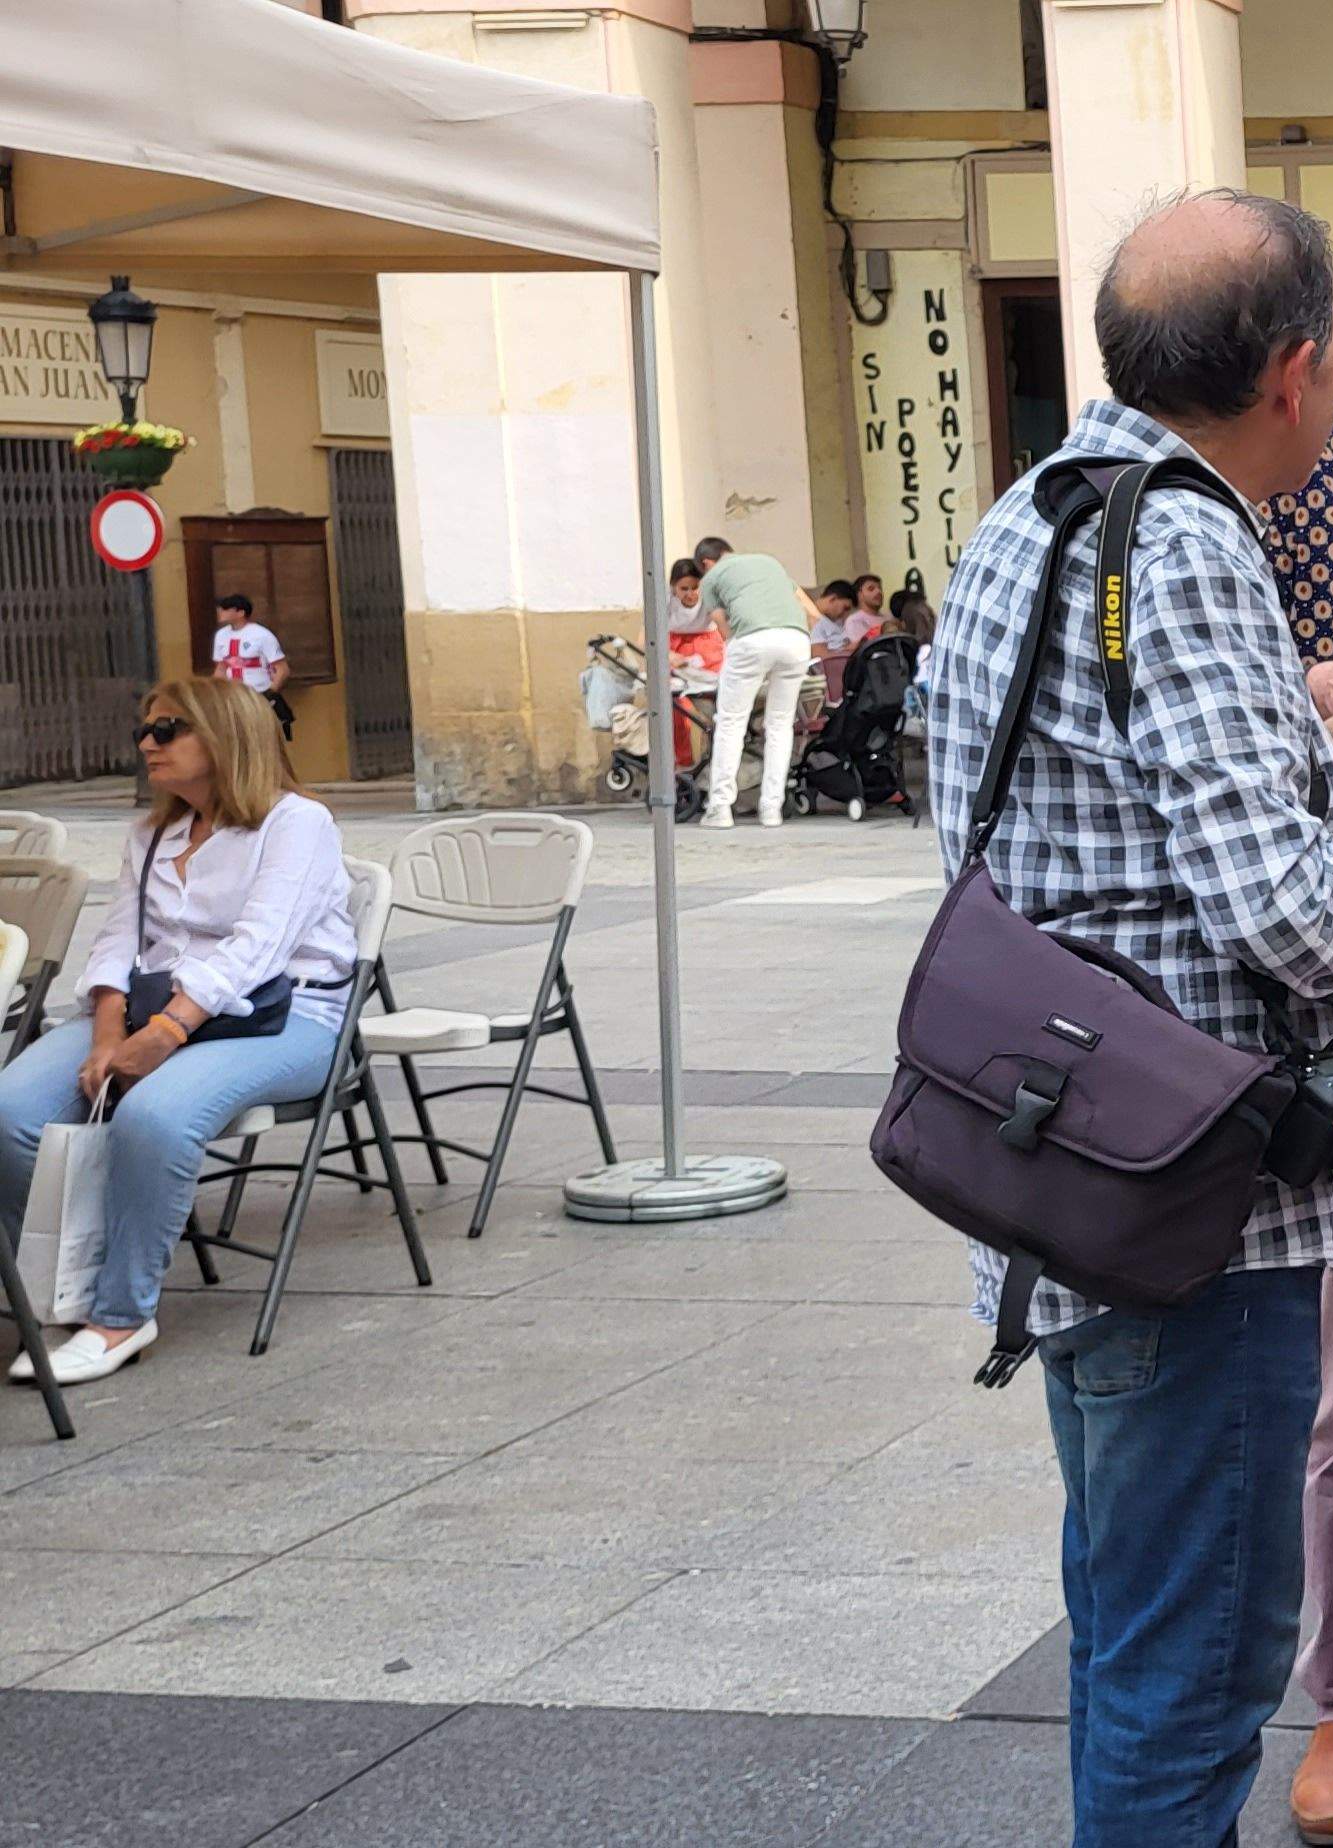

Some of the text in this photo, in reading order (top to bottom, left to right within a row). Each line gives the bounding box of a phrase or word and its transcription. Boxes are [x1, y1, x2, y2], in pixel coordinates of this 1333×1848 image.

[1, 325, 104, 364] MACEN
[40, 366, 110, 401] JUAN
[924, 288, 949, 356] NO
[938, 369, 963, 473] HAY
[862, 353, 887, 454] SIN
[1103, 574, 1124, 661] Nikon
